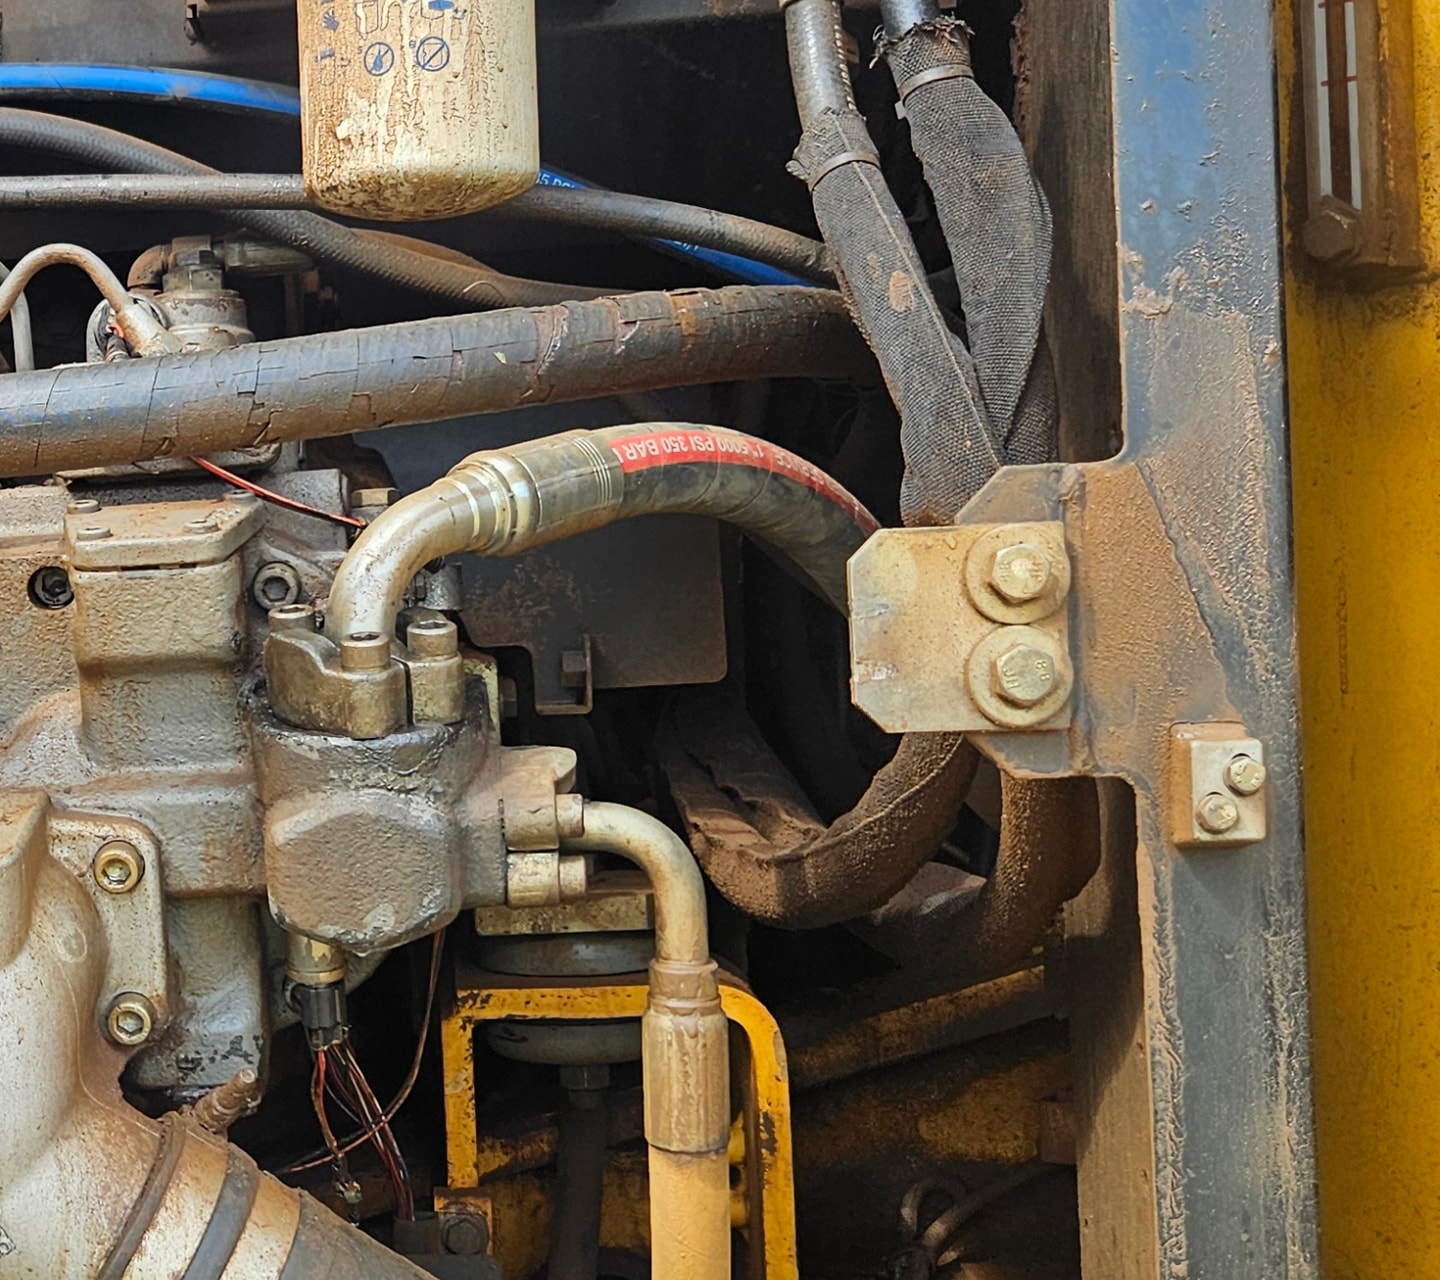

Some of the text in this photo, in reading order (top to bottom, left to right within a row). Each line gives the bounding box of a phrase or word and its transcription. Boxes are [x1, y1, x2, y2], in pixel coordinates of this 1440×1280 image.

[622, 438, 660, 461] BAR
[660, 435, 689, 454] 350
[688, 435, 715, 452] PSI
